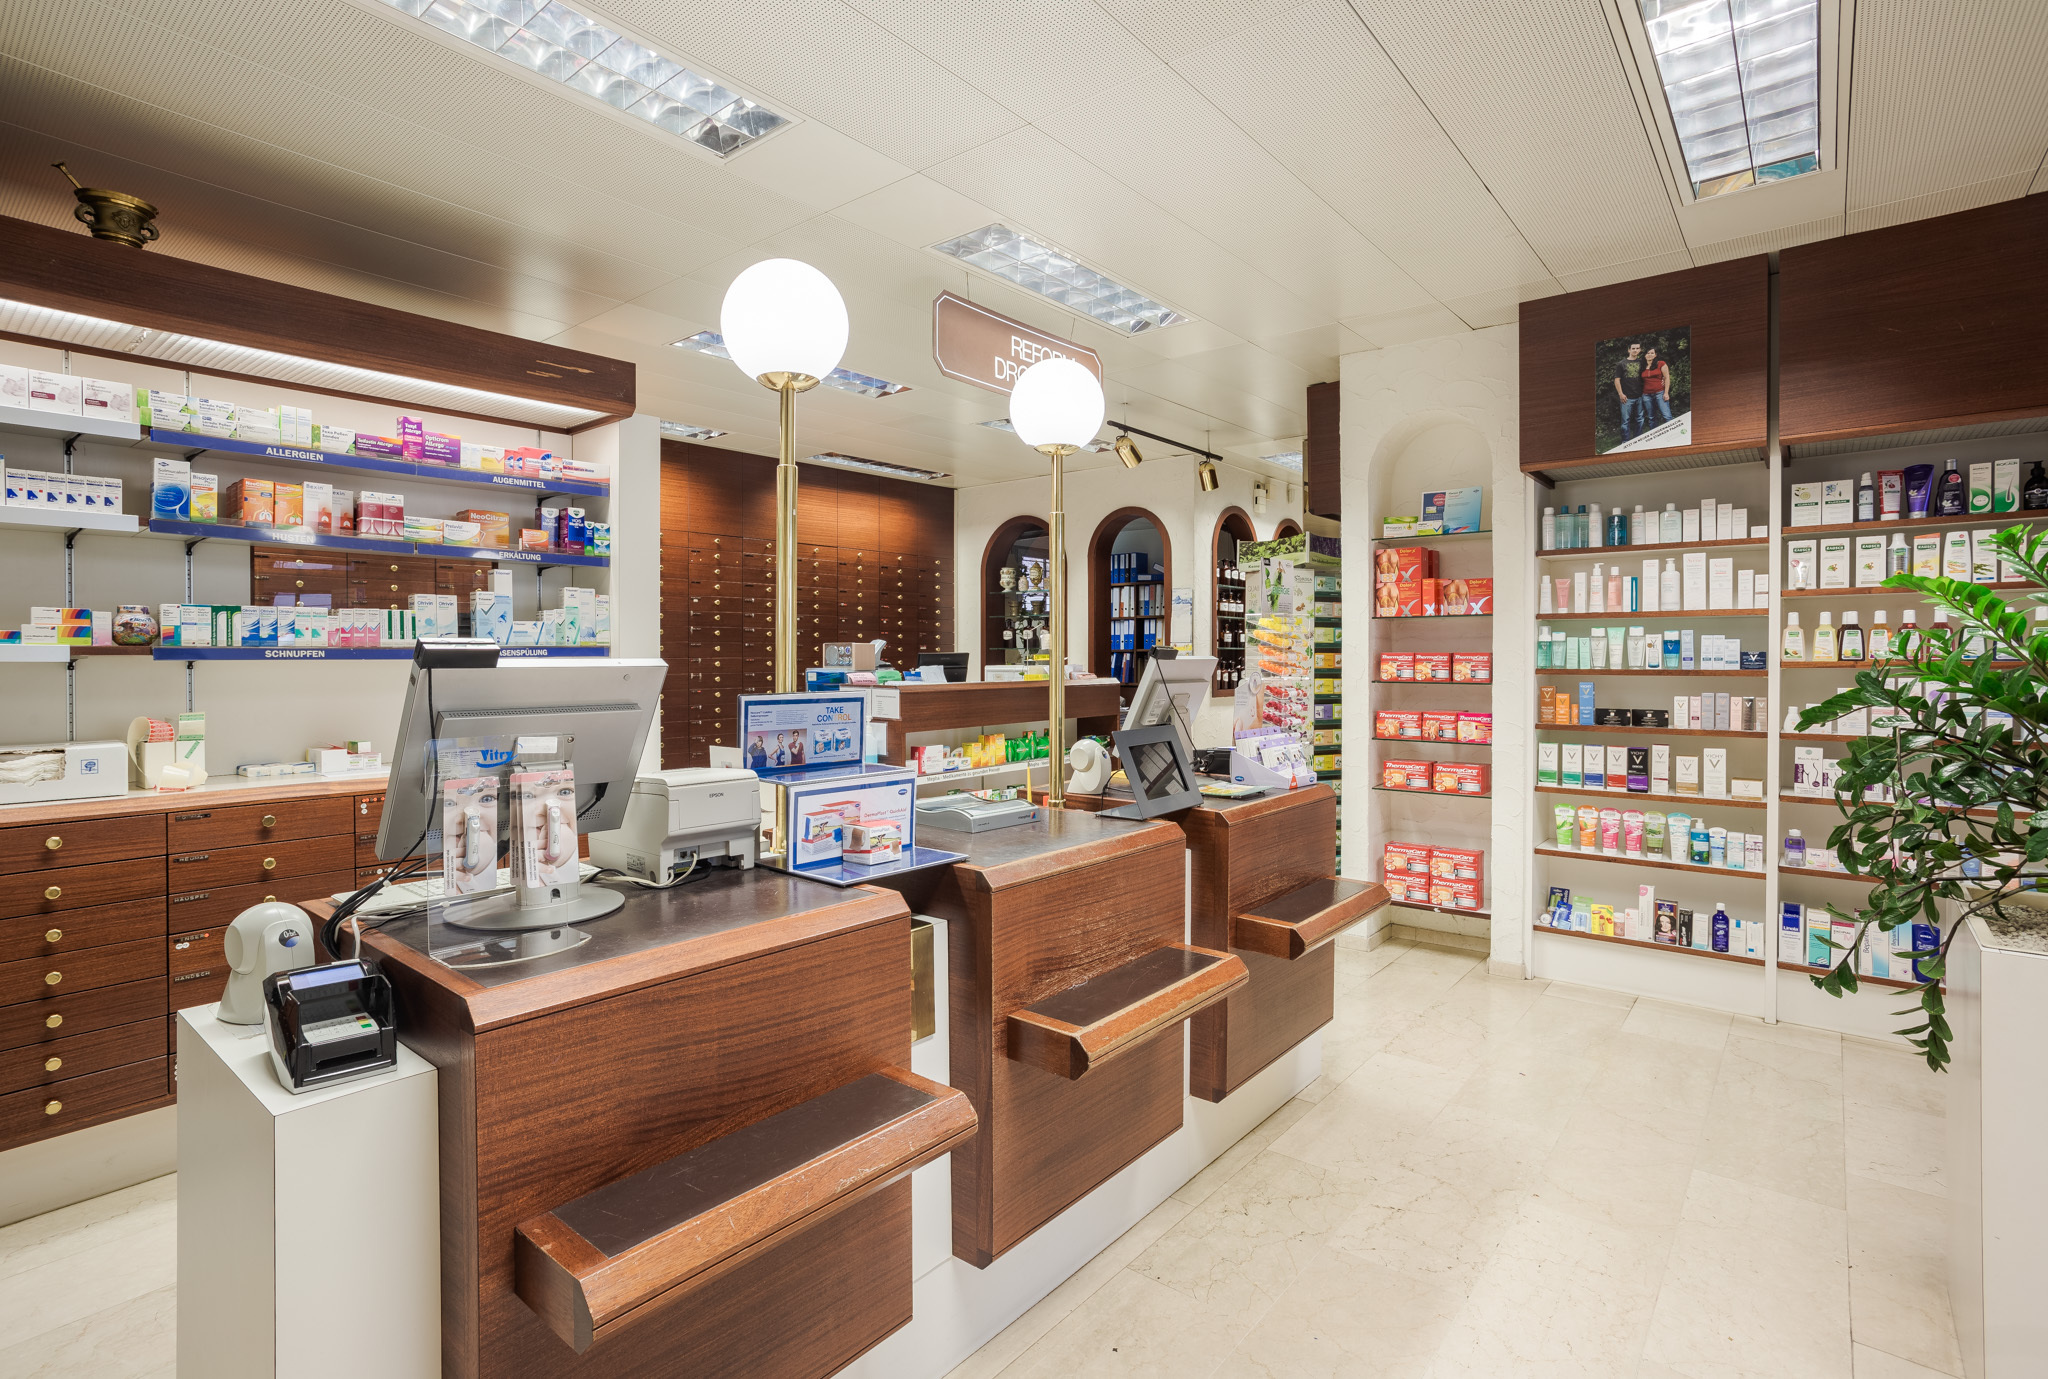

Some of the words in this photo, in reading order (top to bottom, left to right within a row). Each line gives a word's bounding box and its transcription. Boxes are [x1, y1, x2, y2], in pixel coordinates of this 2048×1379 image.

[265, 446, 324, 462] ALLERGIEN
[492, 475, 546, 489] AUGENMITTEL
[470, 512, 509, 522] NeoCitran
[272, 532, 315, 545] HUSTEN
[498, 551, 542, 562] ERKÄLTUNG
[265, 650, 325, 659] SCHNUPFEN
[498, 646, 547, 656] ASENSPÜLUNG
[826, 706, 844, 714] TAKE
[477, 748, 517, 768] Vitry
[1386, 762, 1426, 770] ThermaCare
[1436, 765, 1479, 773] ThermaCare
[1387, 845, 1427, 855] ThermaCare
[1432, 850, 1475, 860] ThermaCare
[1386, 872, 1426, 882] ThermaCare
[1432, 878, 1475, 889] ThermaCare
[284, 929, 298, 938] Orbit
[175, 970, 210, 982] HANDSCH
